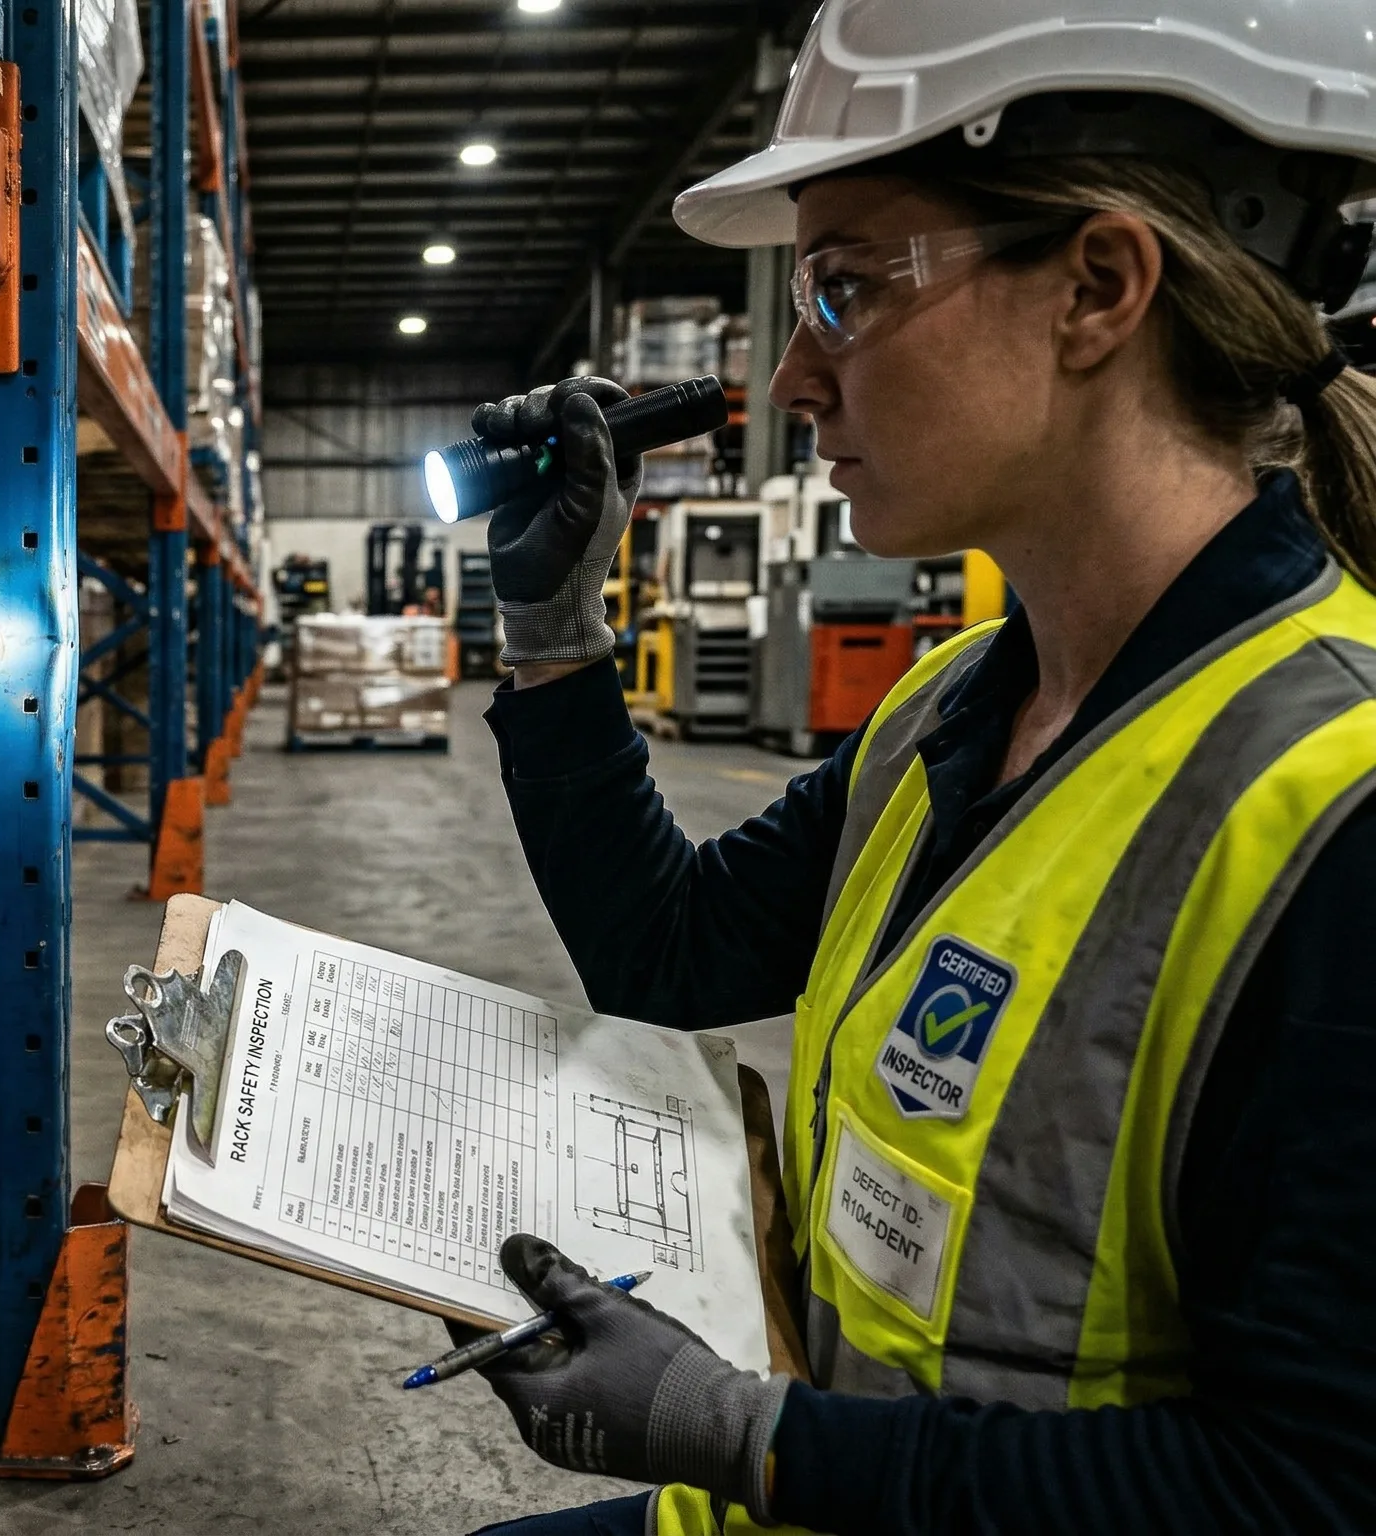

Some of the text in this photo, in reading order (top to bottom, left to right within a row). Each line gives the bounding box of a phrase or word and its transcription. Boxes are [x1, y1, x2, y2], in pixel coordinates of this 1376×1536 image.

[938, 949, 1007, 997] CERTIFIED
[248, 978, 274, 1059] INSPECTION
[238, 1059, 261, 1117] SAFETY
[882, 1045, 964, 1108] INSPECTOR
[230, 1118, 252, 1163] RACK
[841, 1189, 925, 1264] R104-DENT
[852, 1166, 924, 1229] DEFECT ID:
